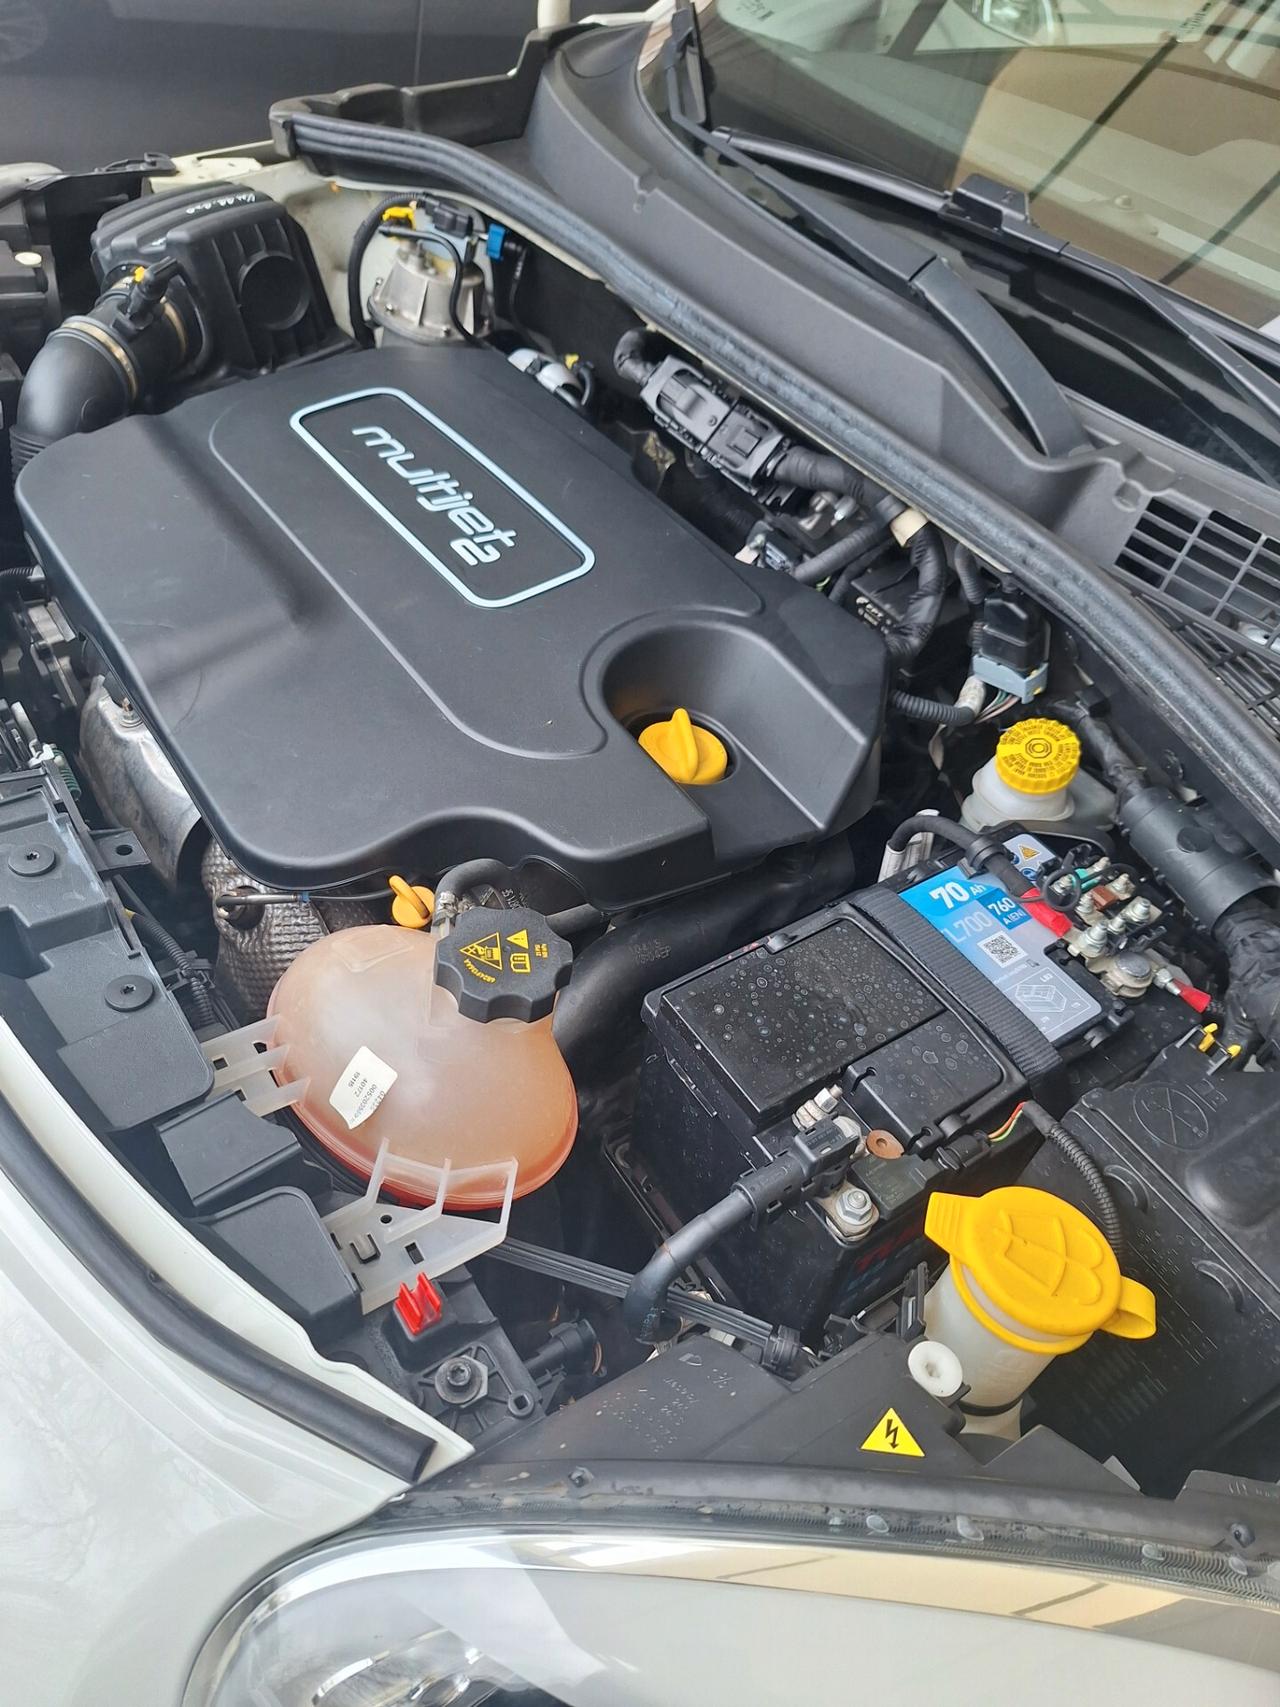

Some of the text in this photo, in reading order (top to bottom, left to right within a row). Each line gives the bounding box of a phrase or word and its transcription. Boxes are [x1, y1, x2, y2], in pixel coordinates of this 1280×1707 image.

[352, 426, 516, 547] multijet
[450, 538, 501, 566] 2
[929, 881, 987, 909] 70 Ah
[987, 897, 1016, 915] 760
[941, 911, 993, 943] L700
